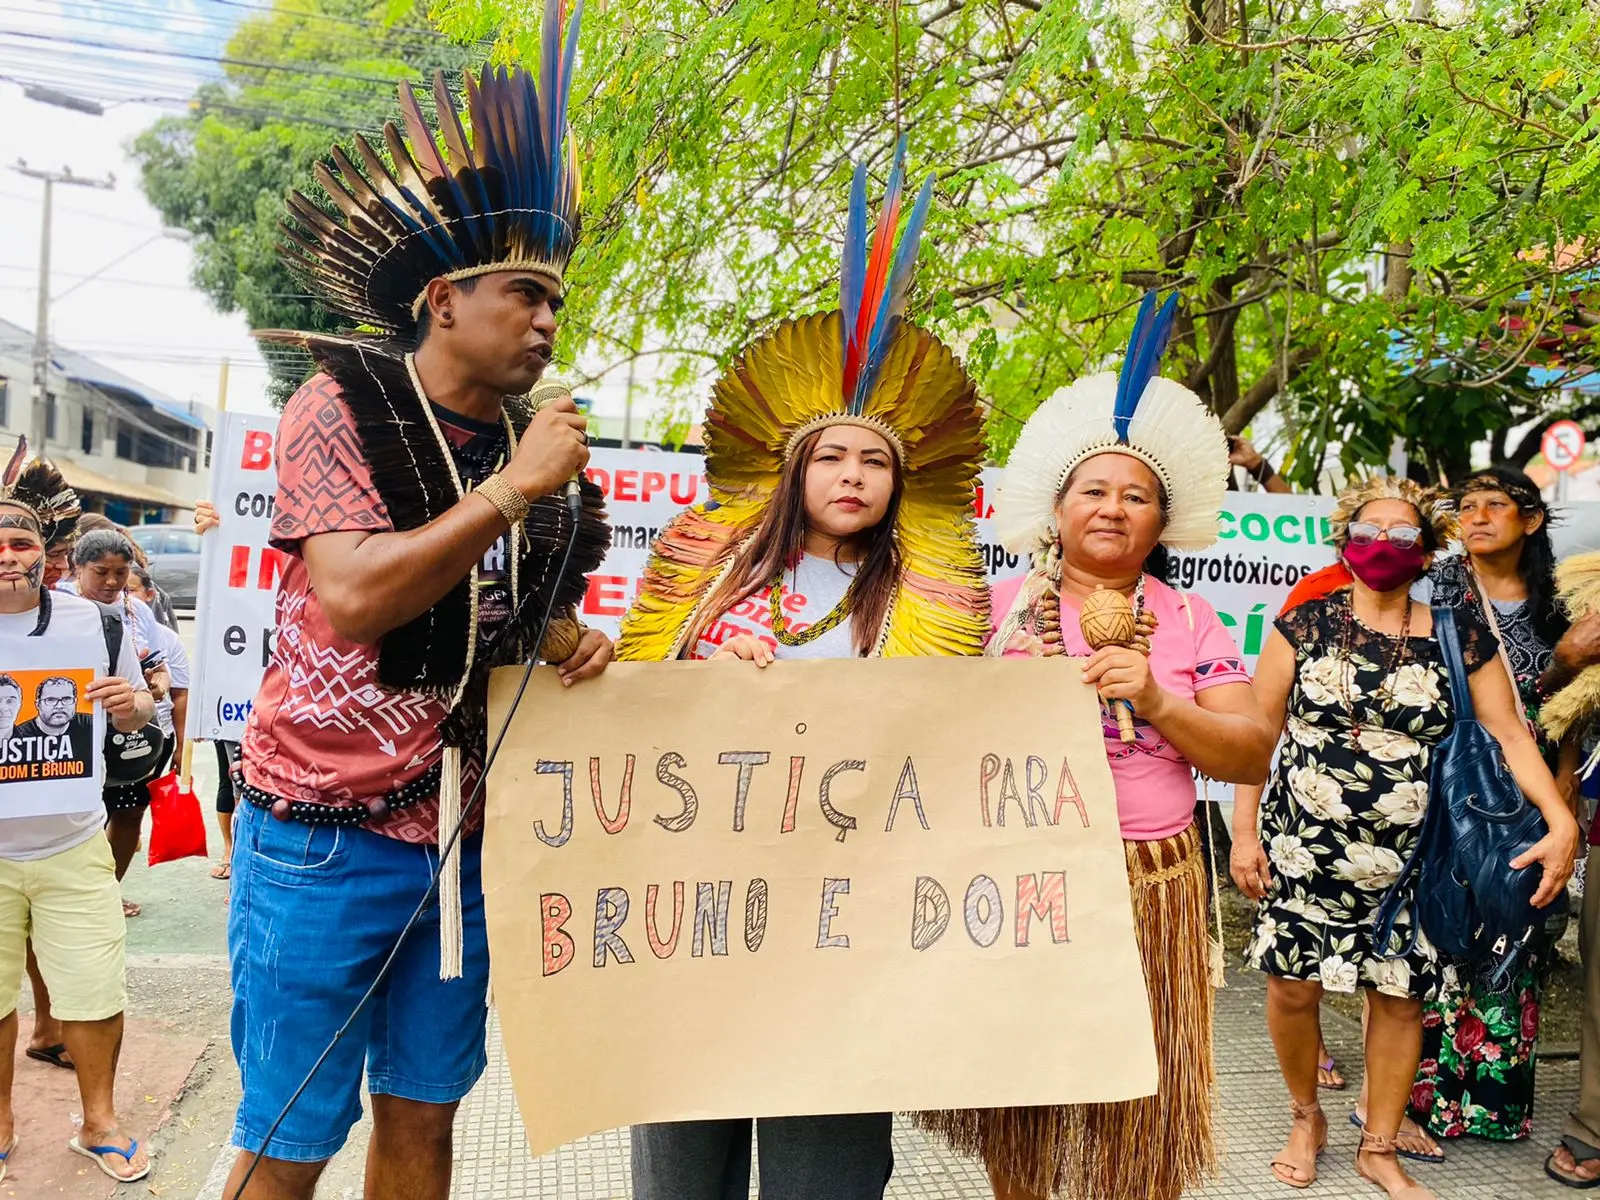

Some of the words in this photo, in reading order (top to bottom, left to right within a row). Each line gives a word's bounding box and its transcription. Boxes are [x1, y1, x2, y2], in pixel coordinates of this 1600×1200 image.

[586, 467, 707, 505] DEPU
[613, 525, 661, 549] mar
[223, 625, 247, 656] e
[0, 763, 28, 780] DOM
[31, 763, 39, 778] E
[42, 760, 84, 777] BRUNO
[533, 722, 931, 848] JUSTIÇA
[980, 752, 1090, 829] PARA
[539, 877, 769, 977] BRUNO
[814, 877, 850, 949] E
[911, 870, 1072, 953] DOM
